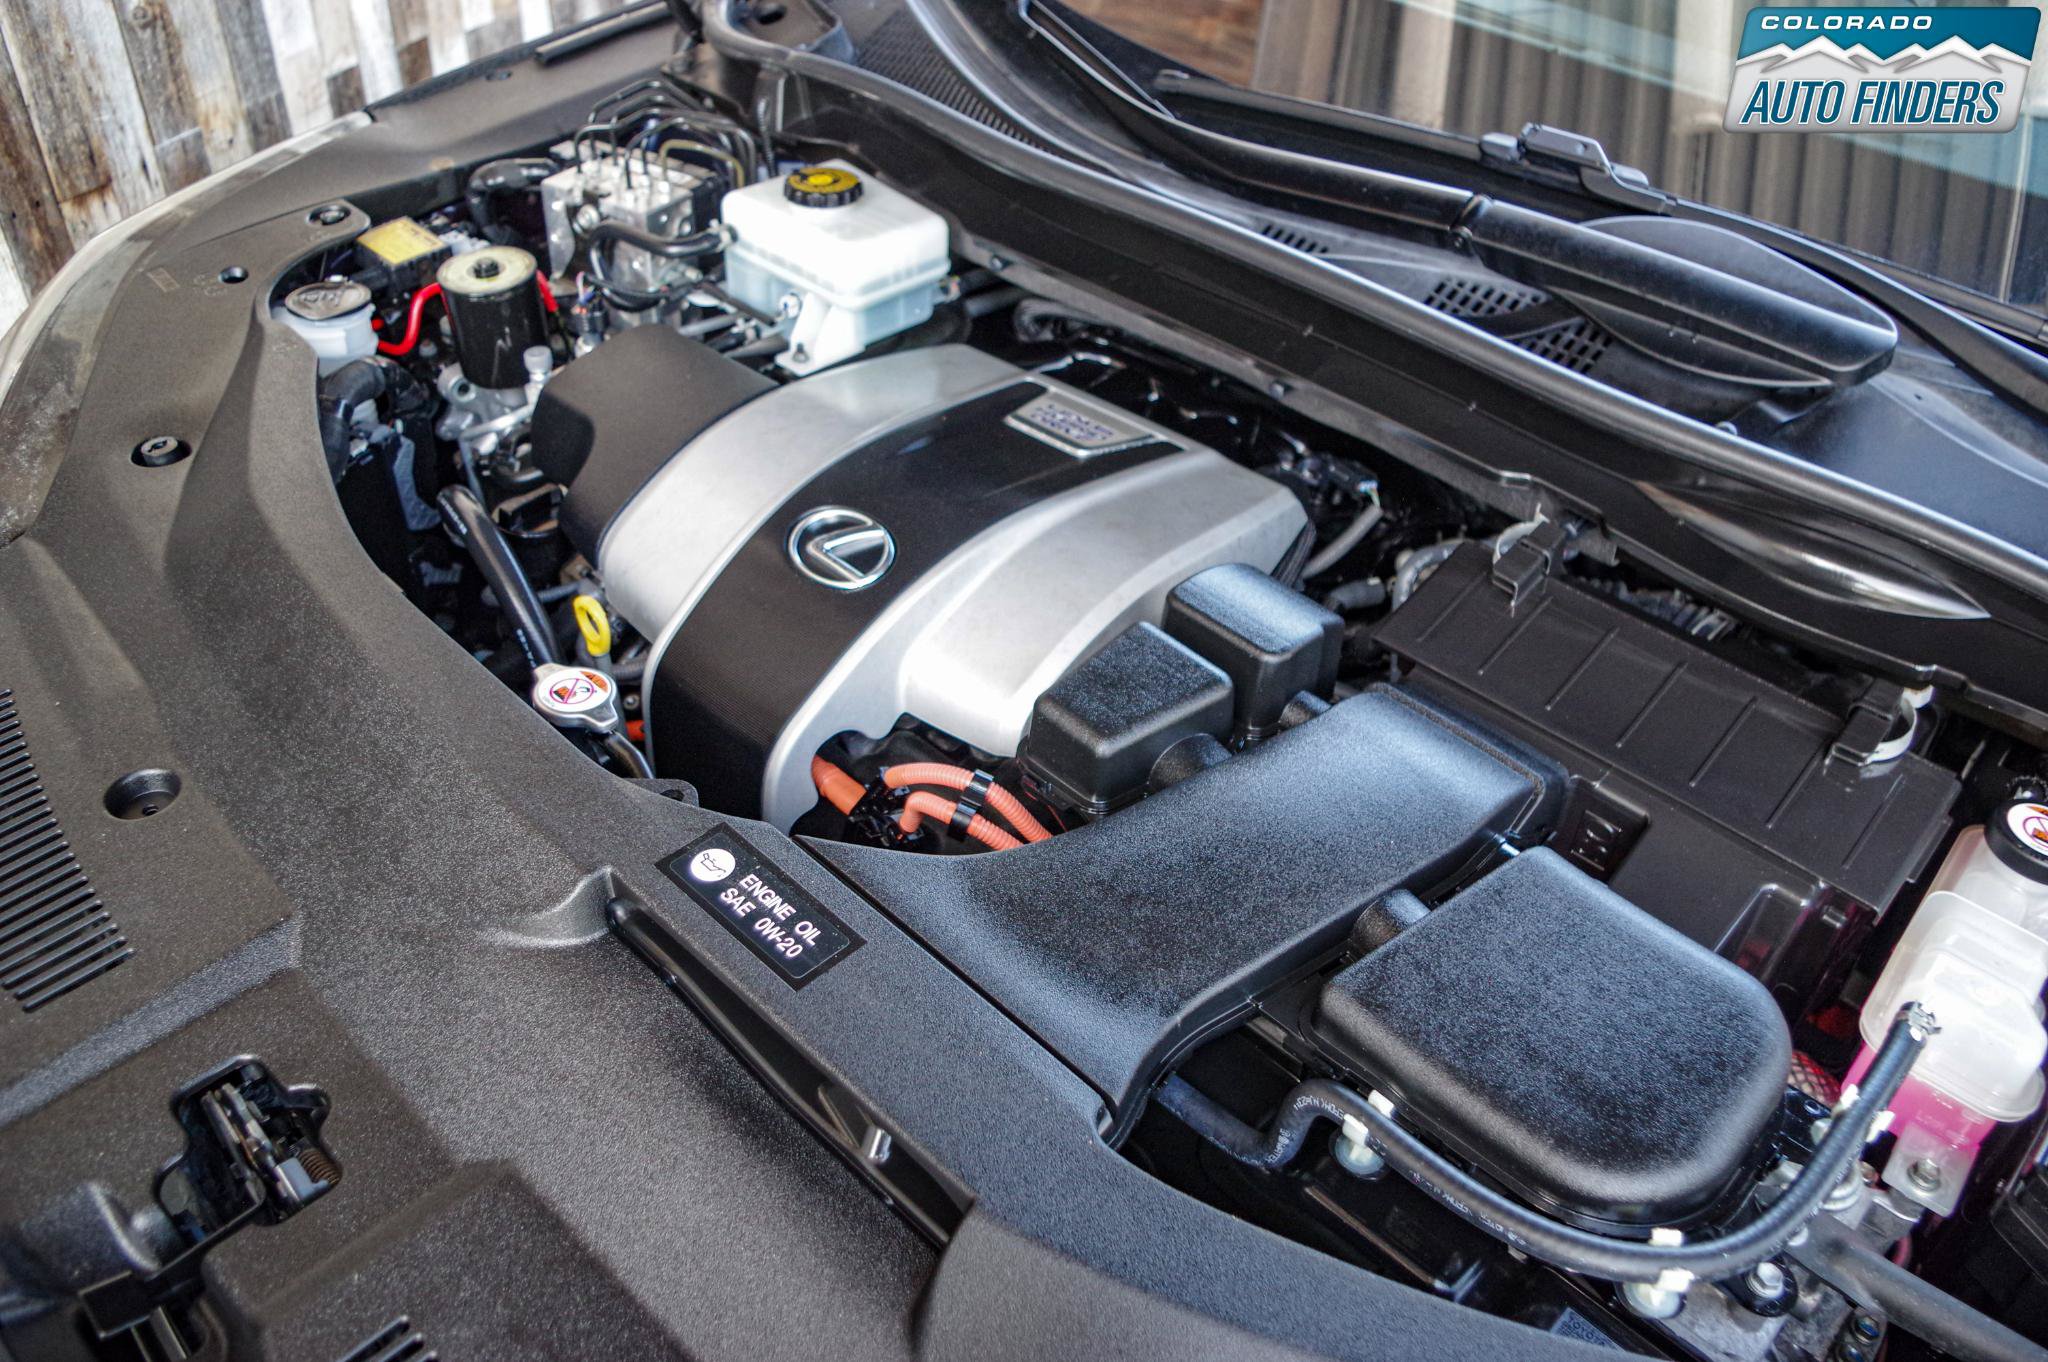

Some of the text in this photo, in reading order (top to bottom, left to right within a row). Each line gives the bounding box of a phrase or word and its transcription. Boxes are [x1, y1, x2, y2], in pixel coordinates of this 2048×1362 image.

[720, 887, 757, 917] SAE
[739, 873, 823, 946] ENGINE OIL
